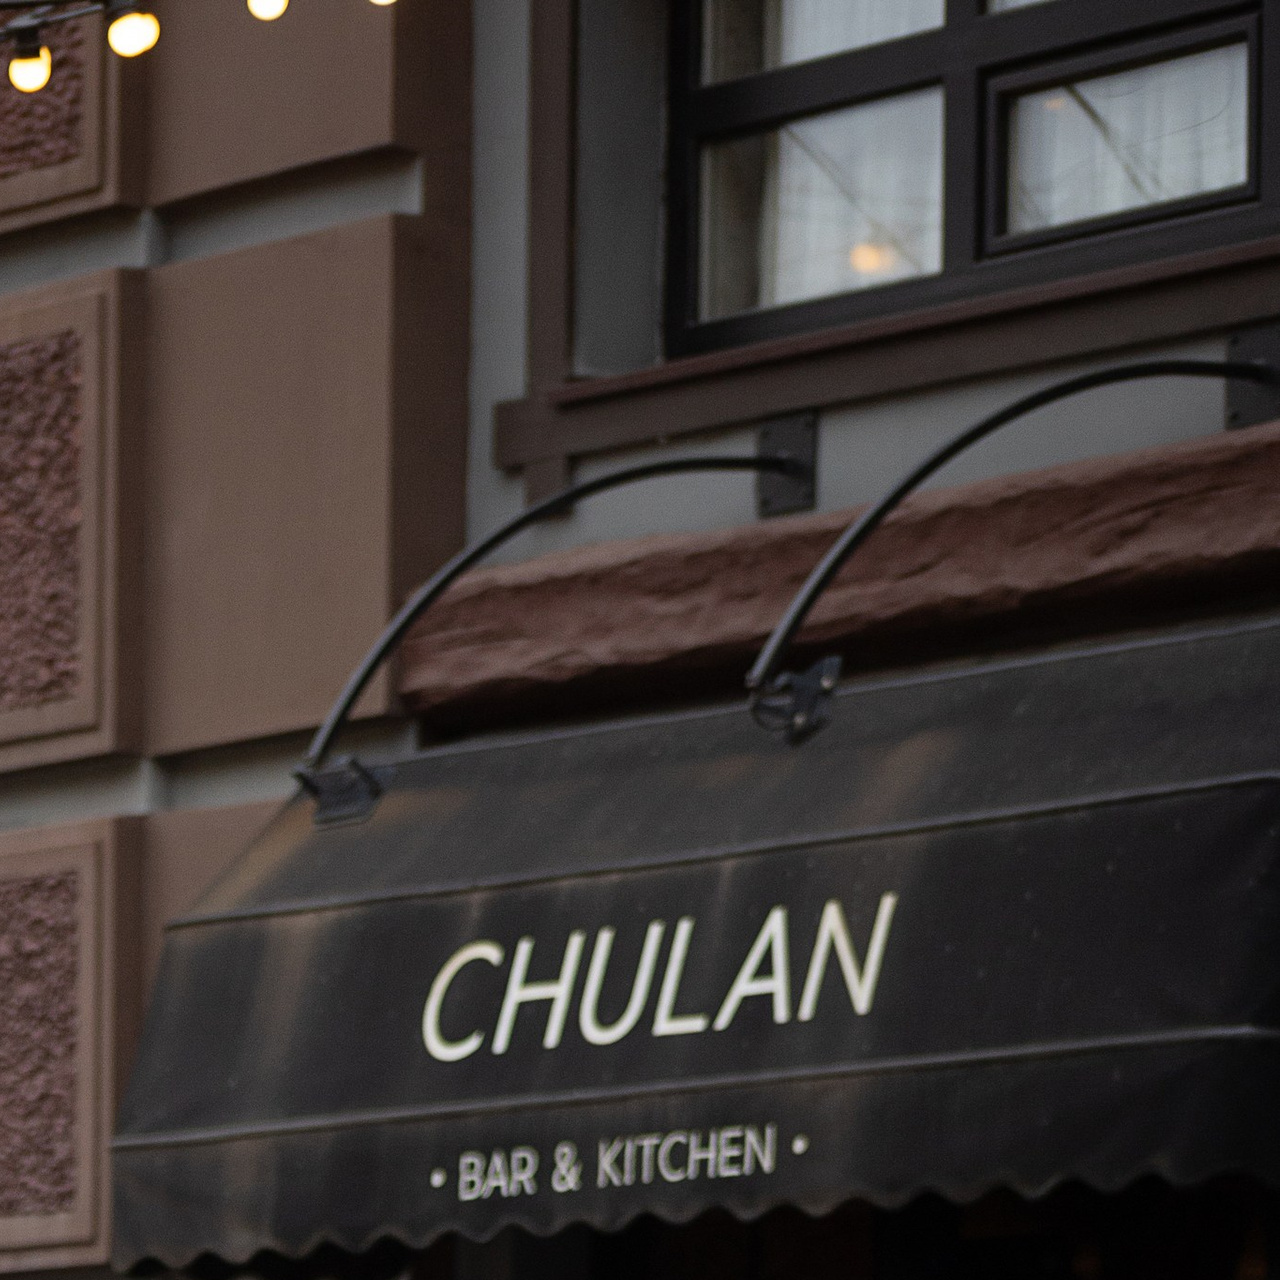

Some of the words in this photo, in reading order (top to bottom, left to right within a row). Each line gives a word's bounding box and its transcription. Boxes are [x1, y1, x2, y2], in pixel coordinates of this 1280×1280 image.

[421, 891, 898, 1063] CHULAN
[457, 1146, 538, 1201] BAR
[551, 1138, 583, 1194] &
[596, 1123, 777, 1187] KITCHEN
